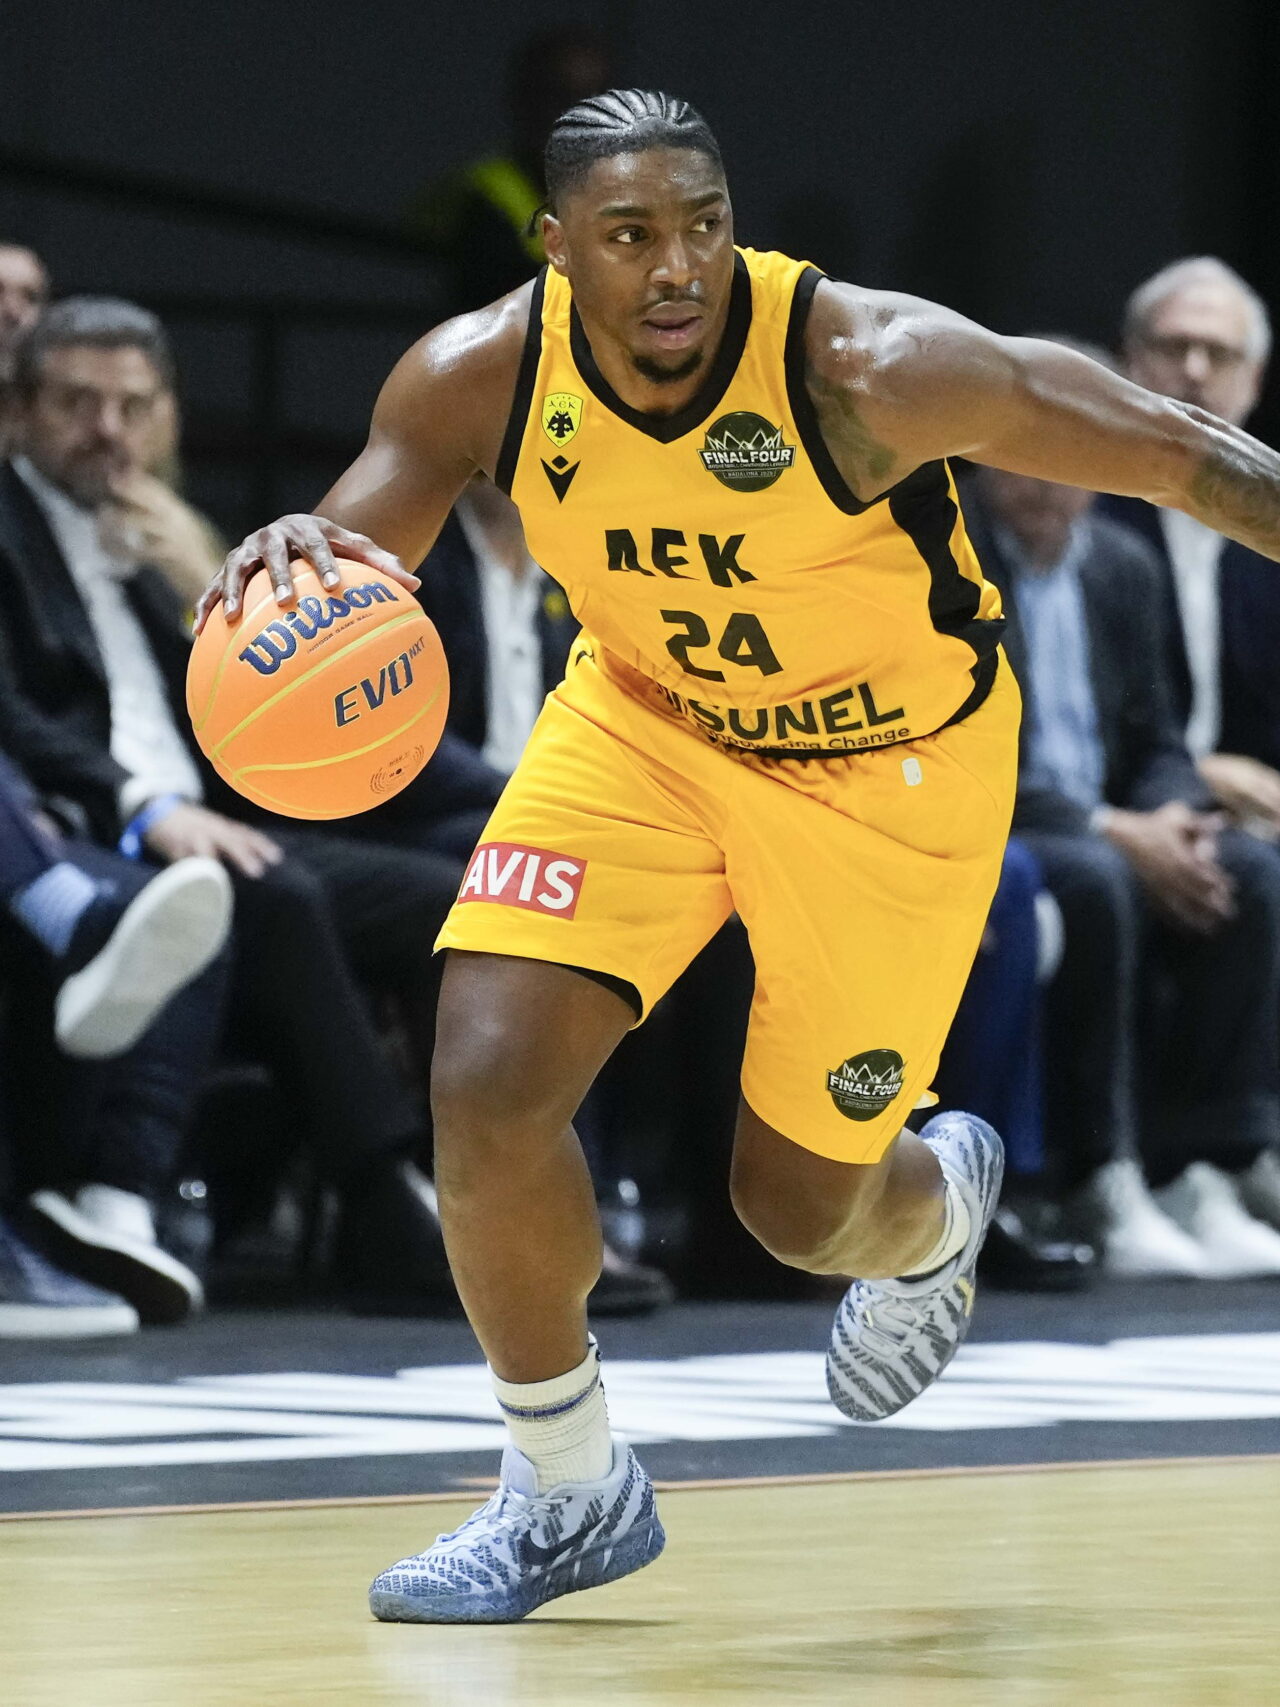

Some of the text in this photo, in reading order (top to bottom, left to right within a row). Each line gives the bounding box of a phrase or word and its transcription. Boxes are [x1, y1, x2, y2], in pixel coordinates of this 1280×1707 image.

[702, 449, 792, 464] FINAL FOUR
[604, 527, 759, 588] AEK
[237, 580, 400, 676] Wilson
[660, 609, 784, 683] 24
[333, 636, 426, 728] EVO NXT
[687, 681, 905, 741] SUNEL
[828, 728, 910, 750] Change
[460, 848, 580, 910] AVIS
[829, 1075, 871, 1096] FINAL
[872, 1082, 902, 1096] FOUR
